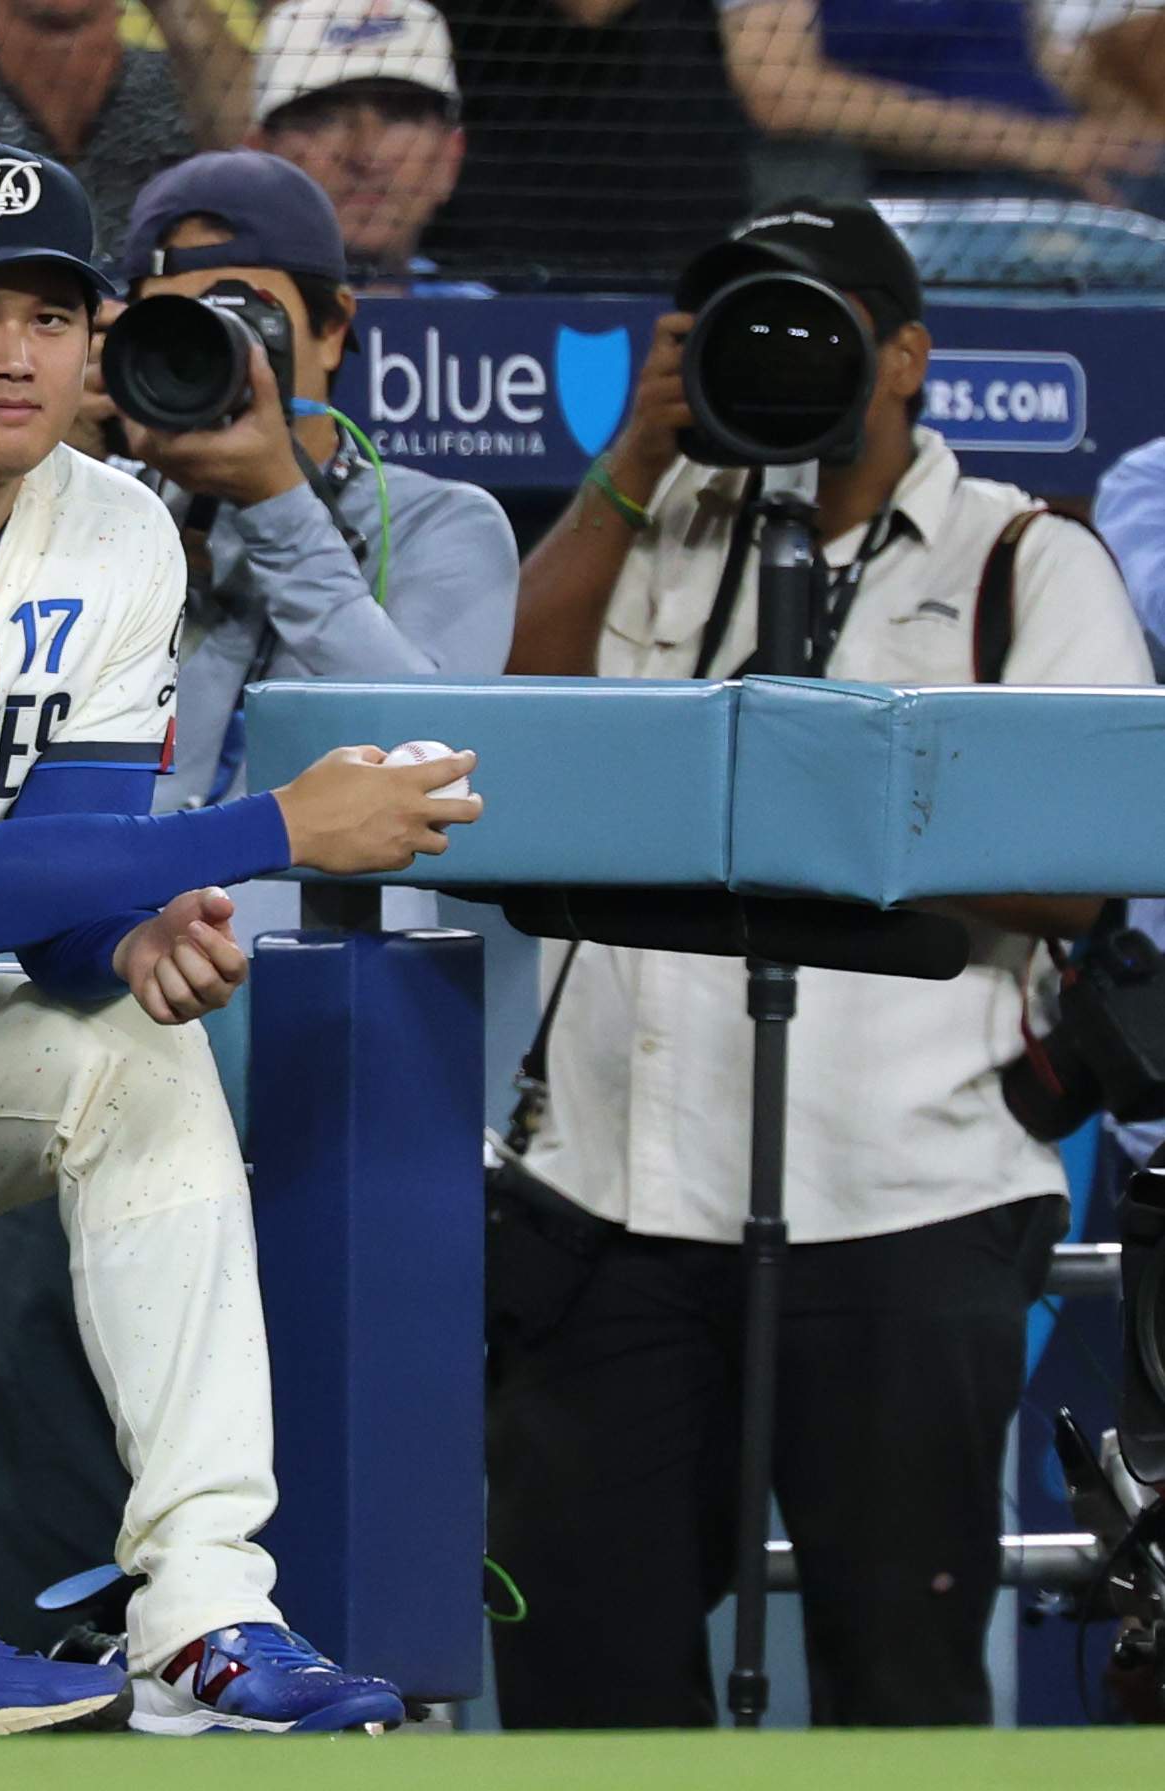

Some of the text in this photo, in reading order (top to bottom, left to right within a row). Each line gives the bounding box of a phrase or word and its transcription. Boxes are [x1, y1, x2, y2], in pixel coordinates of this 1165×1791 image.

[369, 326, 546, 423] blue
[371, 430, 546, 456] CALIFORNIA
[9, 598, 83, 674] 17
